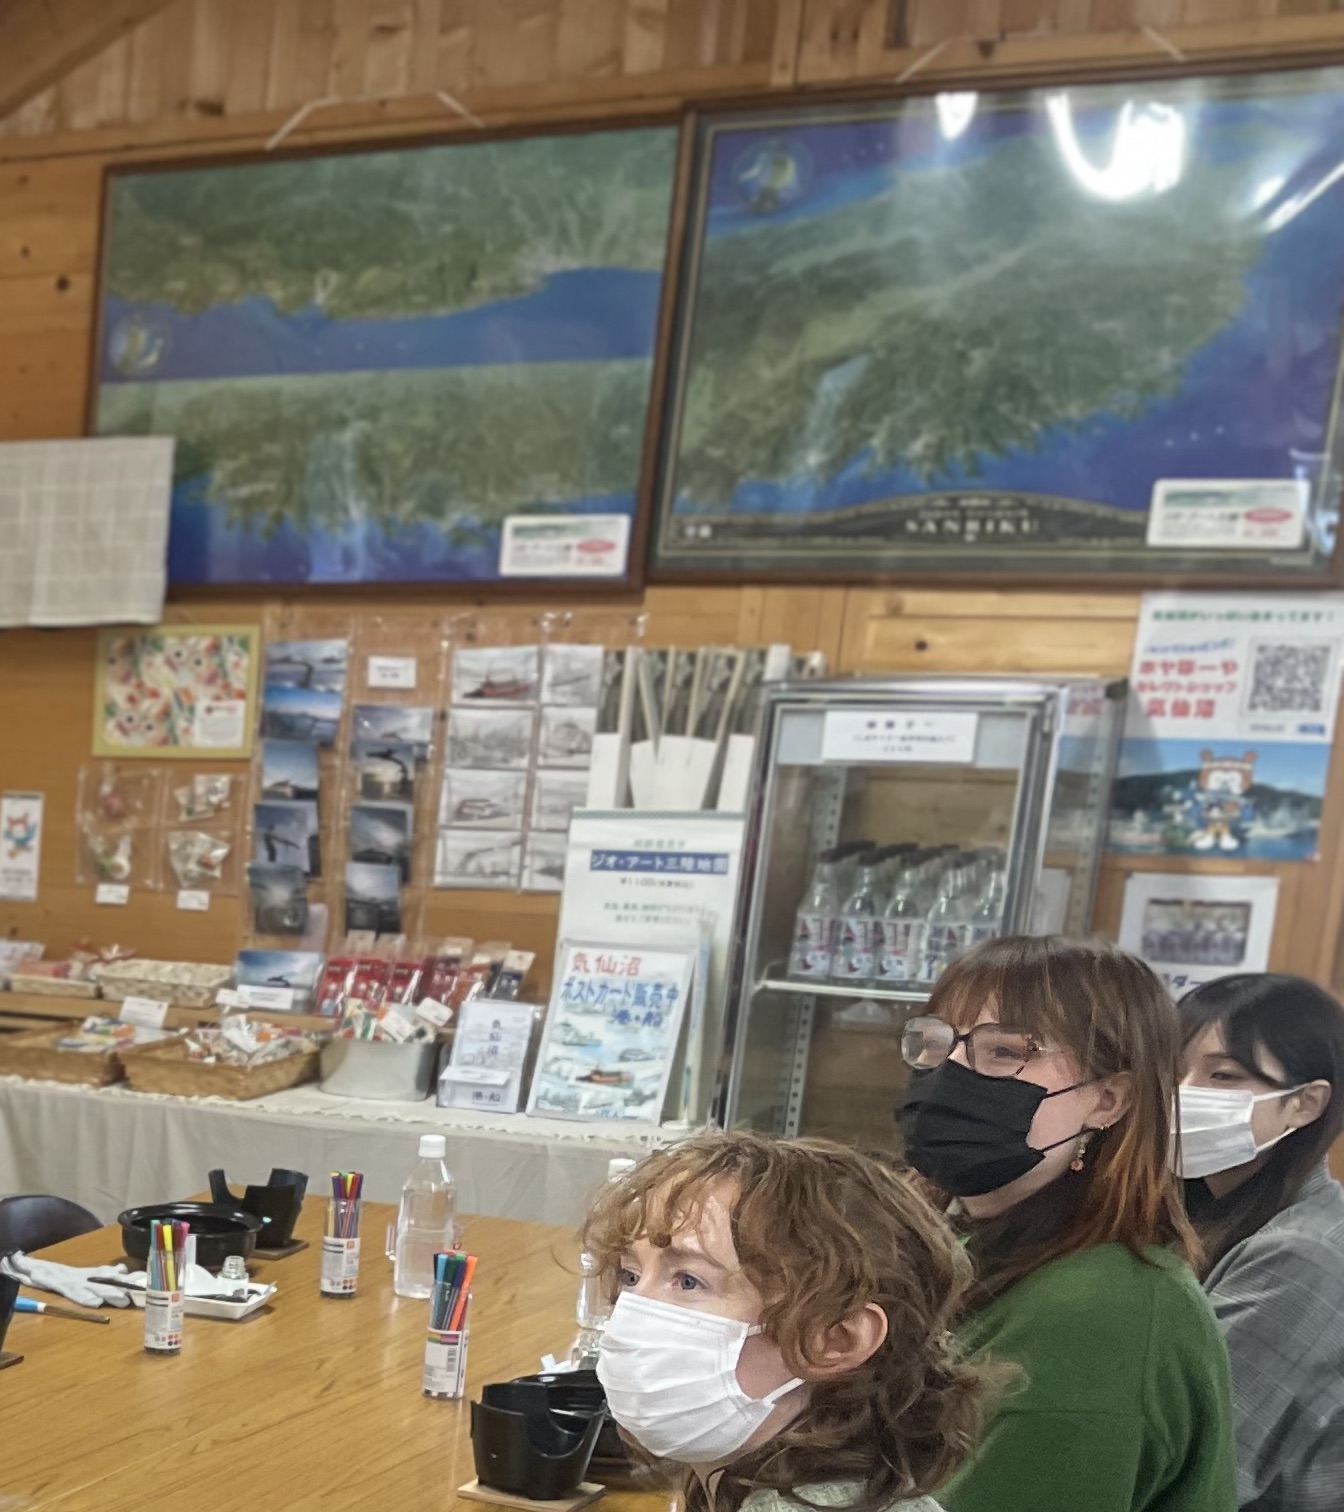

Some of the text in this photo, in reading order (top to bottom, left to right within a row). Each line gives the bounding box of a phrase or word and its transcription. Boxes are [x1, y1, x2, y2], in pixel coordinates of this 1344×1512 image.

[571, 952, 642, 976] 気仙沼
[561, 976, 679, 1011] ポストカード販売中
